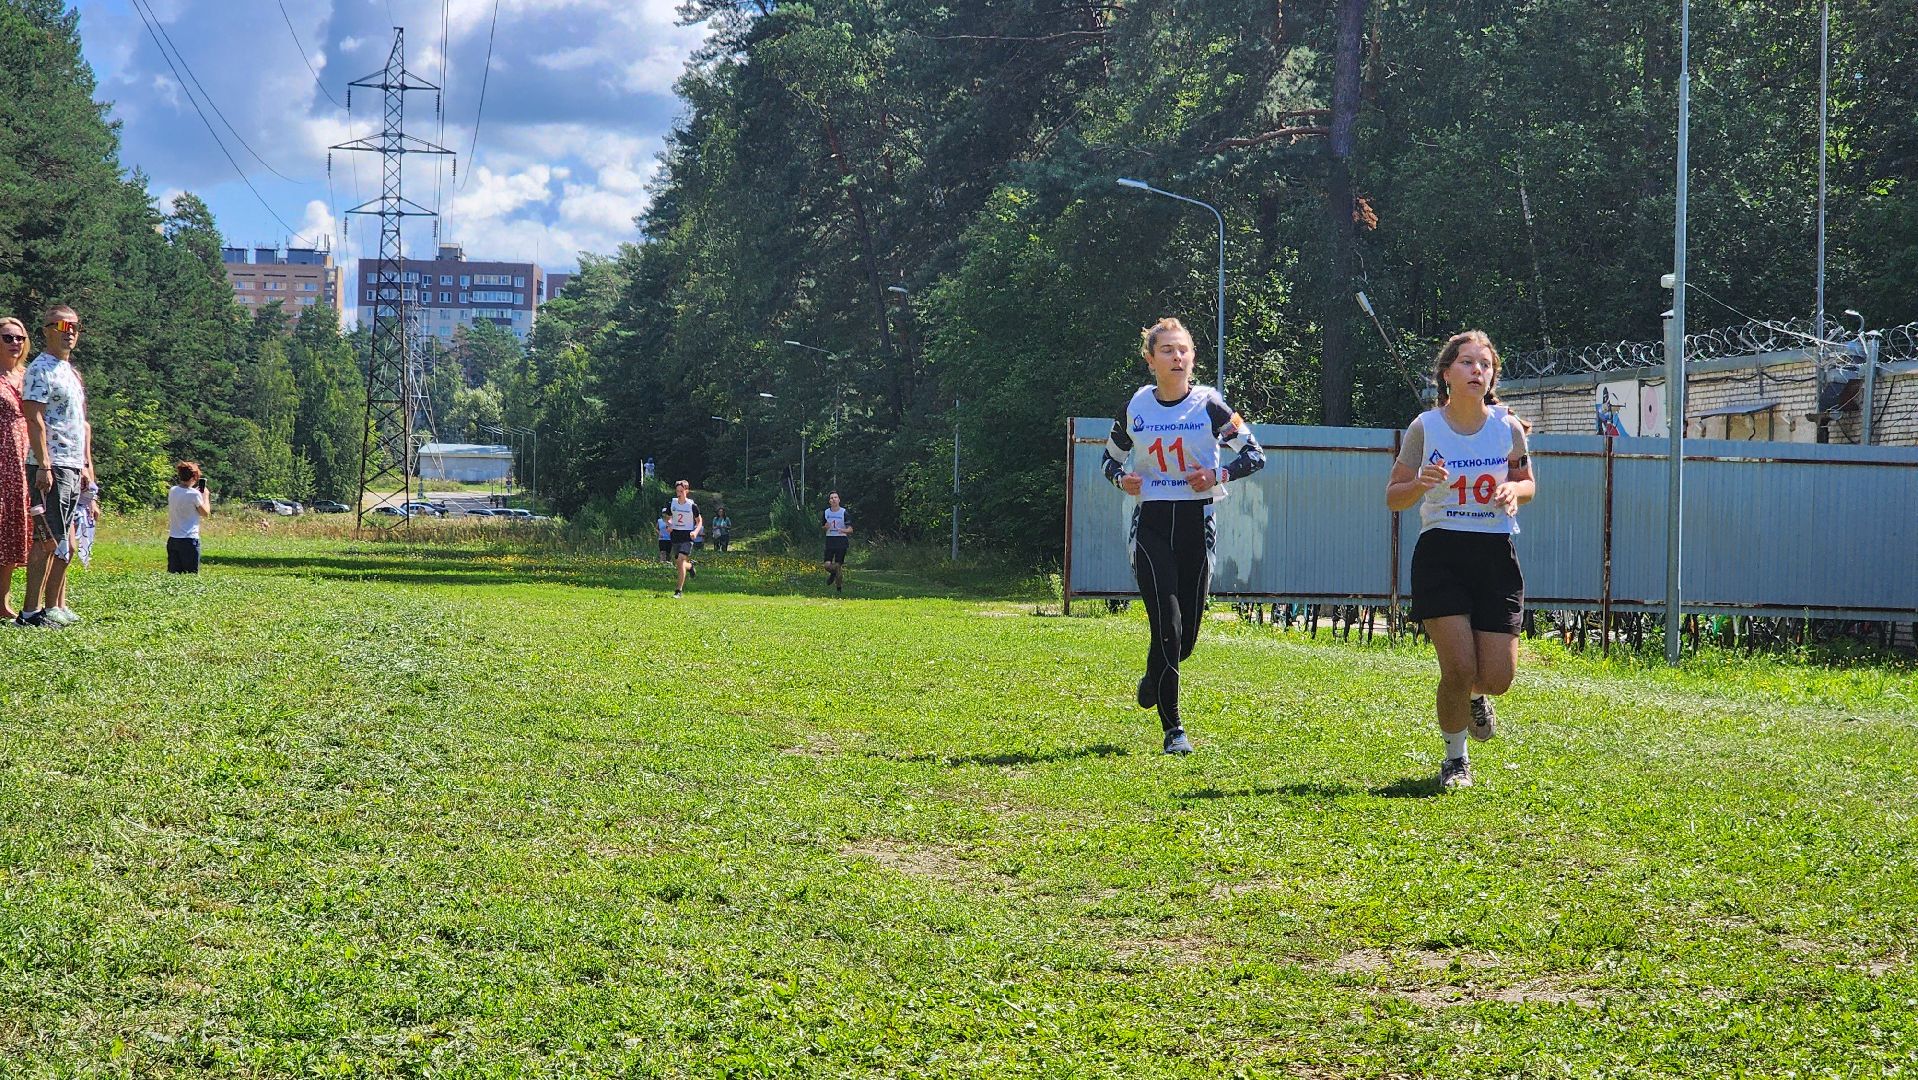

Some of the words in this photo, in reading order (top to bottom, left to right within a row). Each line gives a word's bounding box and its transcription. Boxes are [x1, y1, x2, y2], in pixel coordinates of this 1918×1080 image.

[1148, 437, 1186, 472] 11
[1450, 474, 1496, 505] 10
[677, 513, 684, 523] 2
[831, 519, 836, 528] 1
